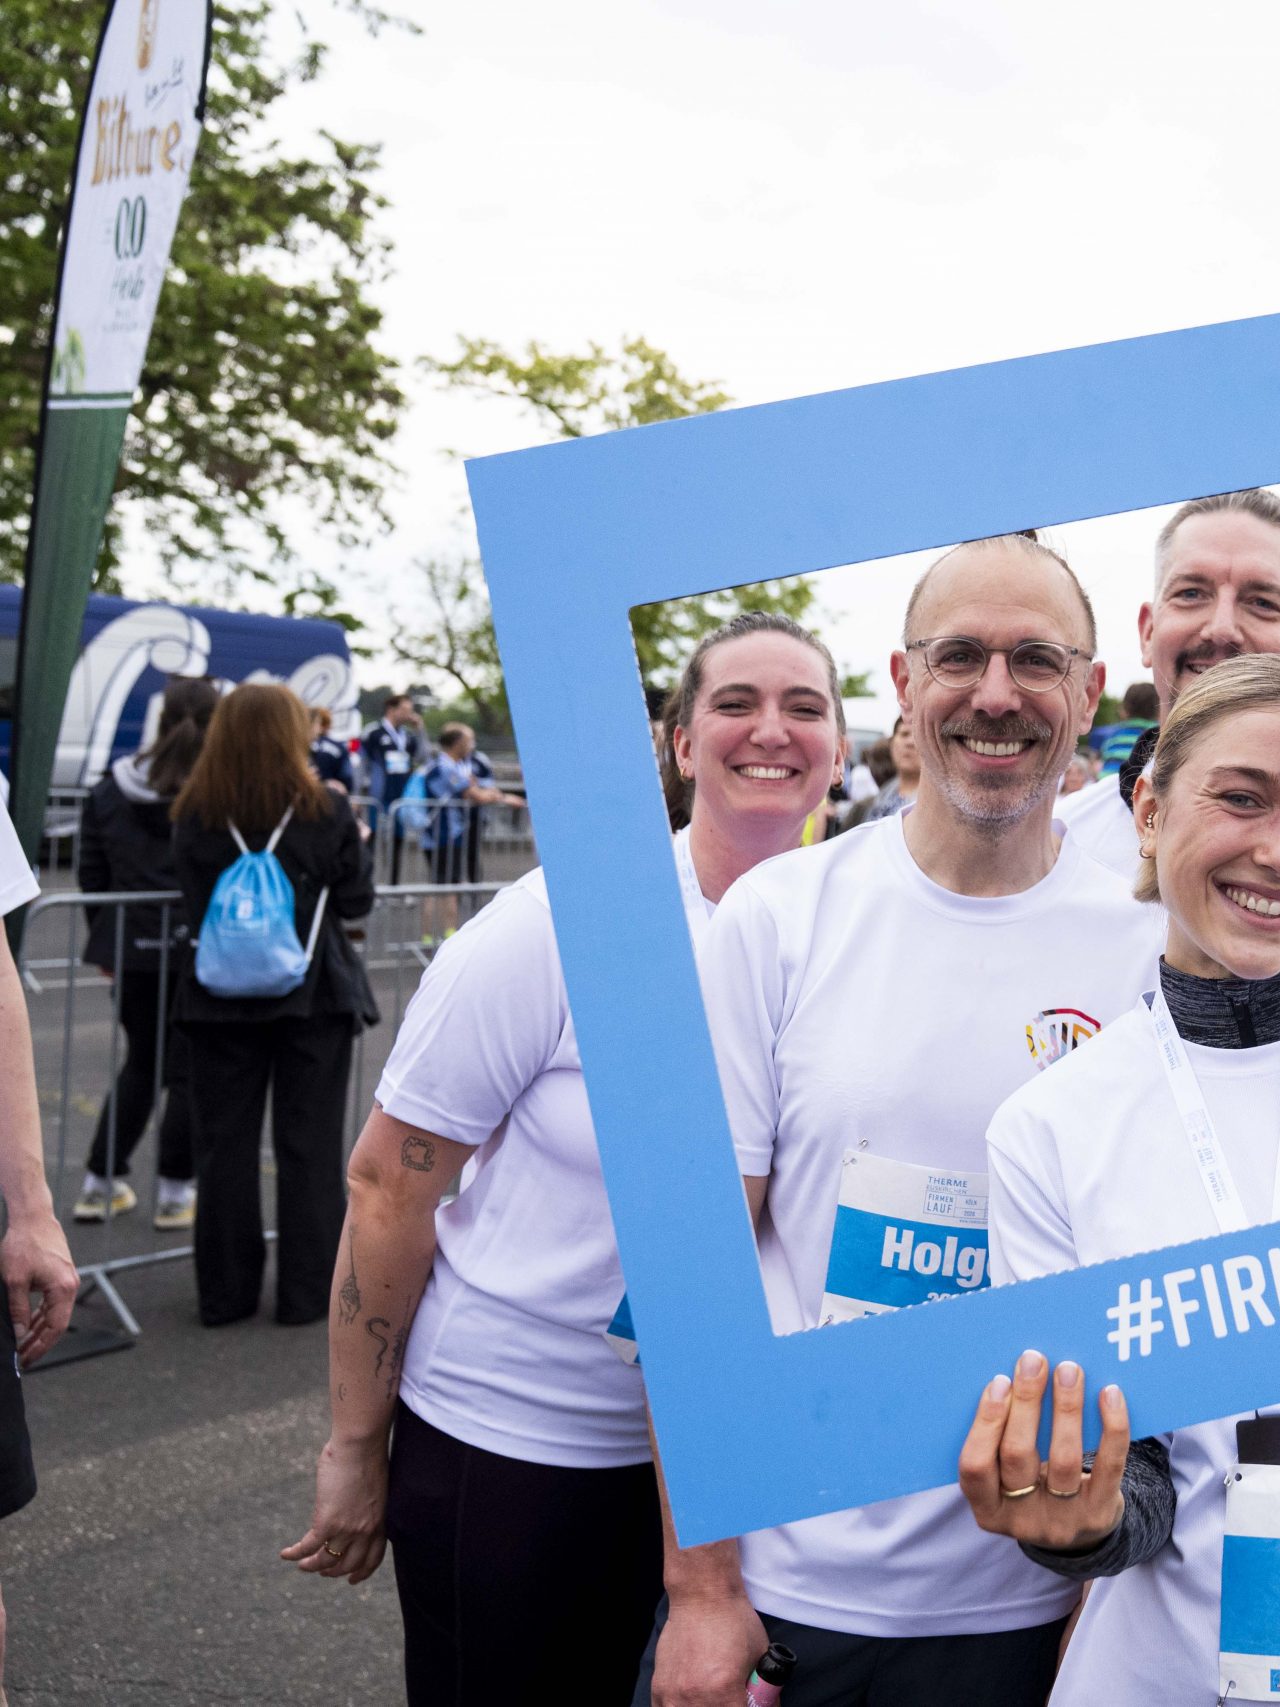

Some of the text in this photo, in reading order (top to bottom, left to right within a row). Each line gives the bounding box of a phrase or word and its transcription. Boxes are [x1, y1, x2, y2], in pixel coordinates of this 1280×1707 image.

[928, 1176, 968, 1188] THERME
[928, 1193, 954, 1203] FIRMEN
[927, 1201, 952, 1214] LAUF
[881, 1225, 991, 1288] Holg
